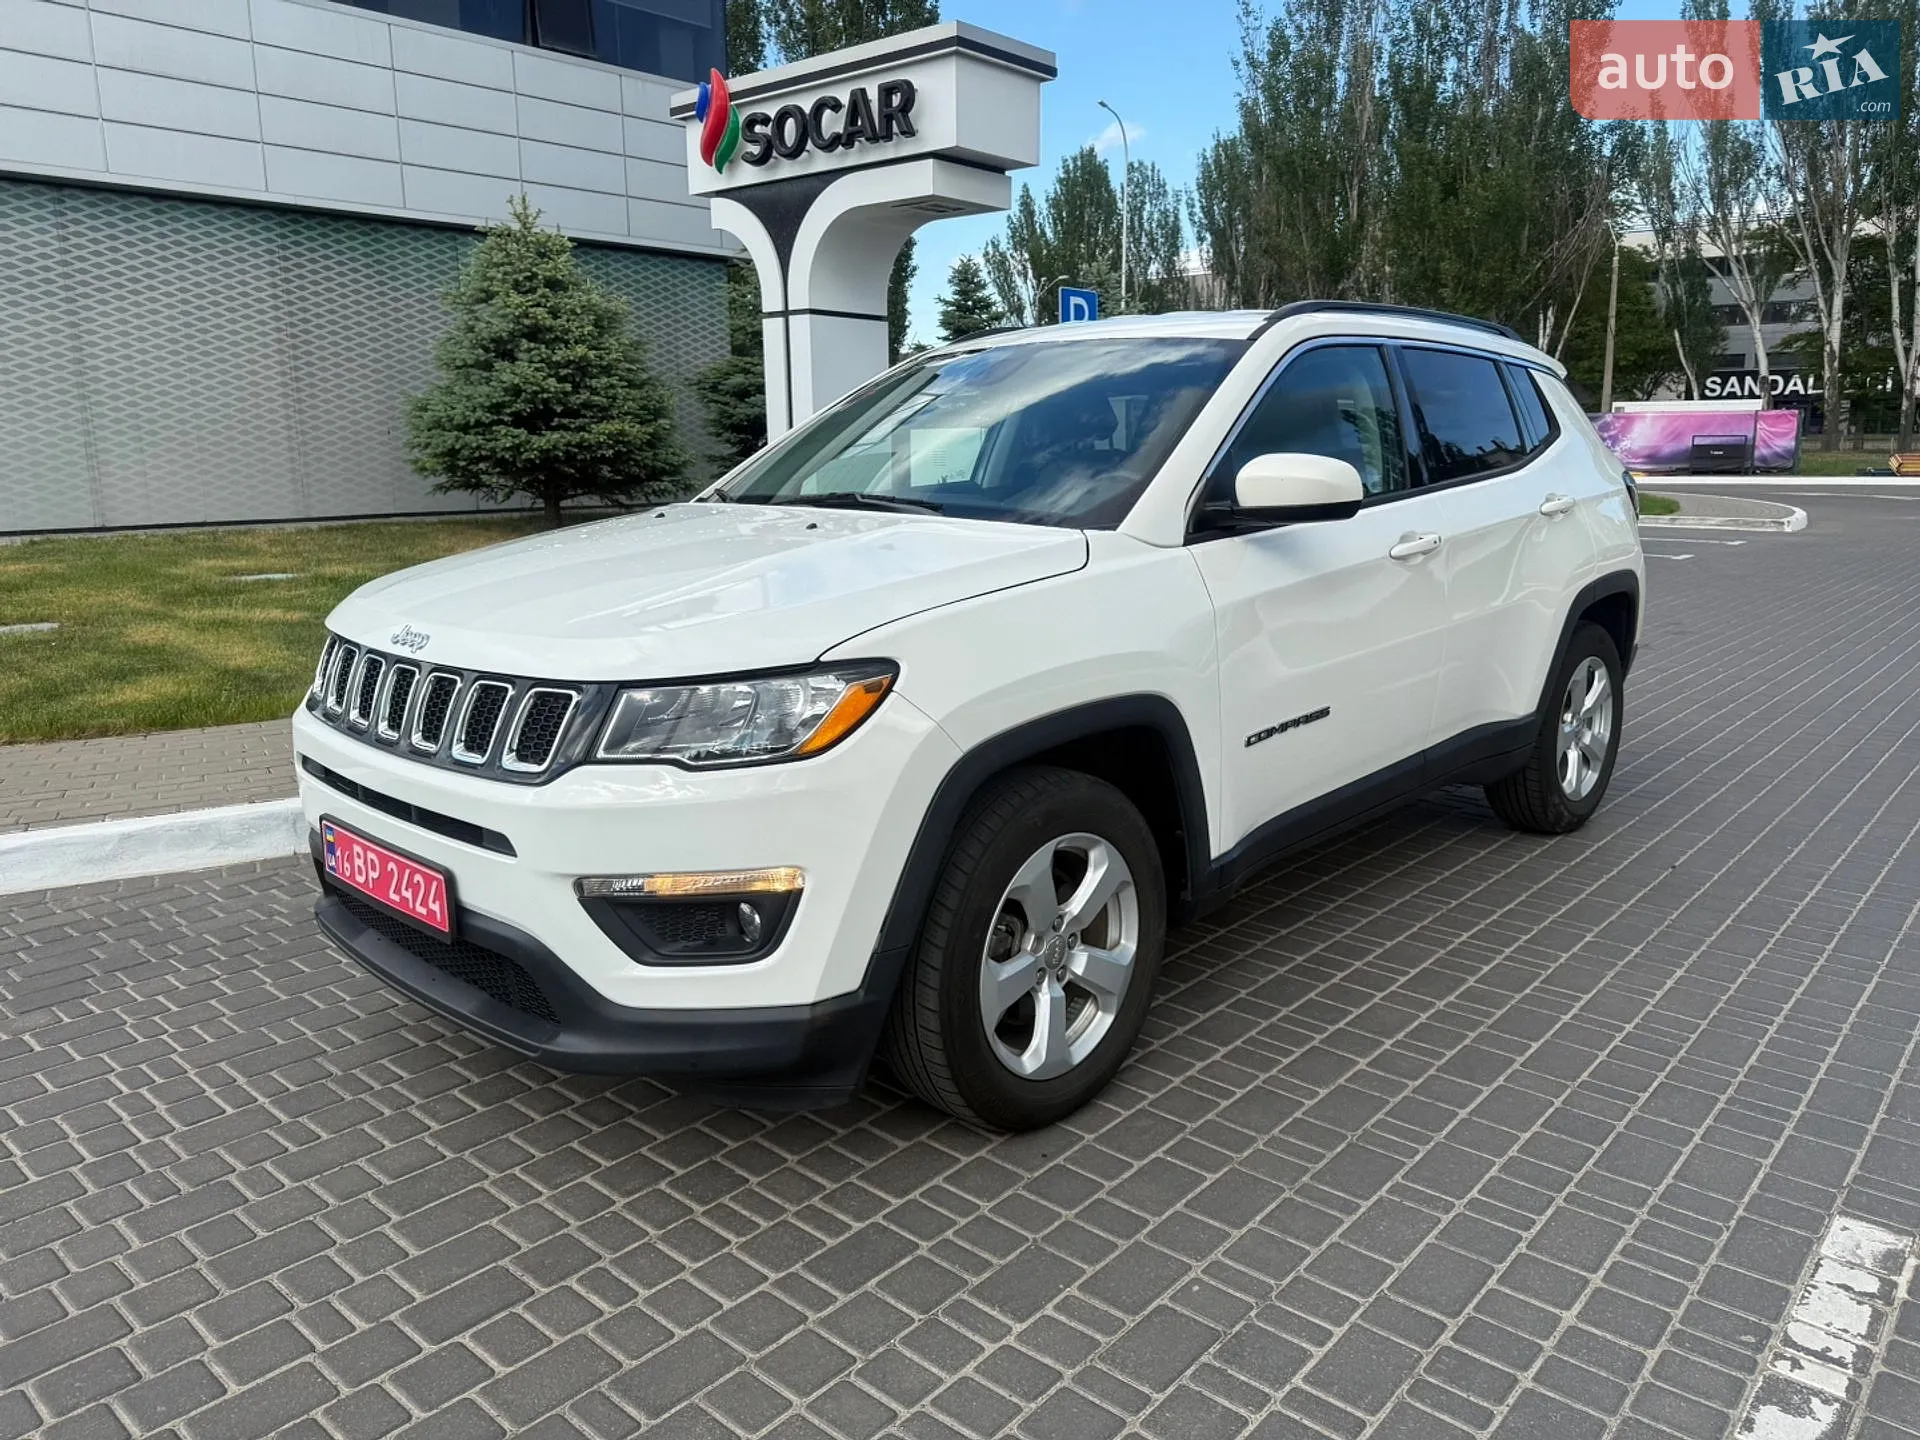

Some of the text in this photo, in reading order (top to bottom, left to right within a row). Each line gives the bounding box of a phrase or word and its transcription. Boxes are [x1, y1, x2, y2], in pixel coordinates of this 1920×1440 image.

[741, 78, 917, 168] SOCAR
[390, 623, 431, 654] Jeep
[1244, 706, 1331, 748] COMPASS
[336, 843, 442, 923] 16 BP 2424
